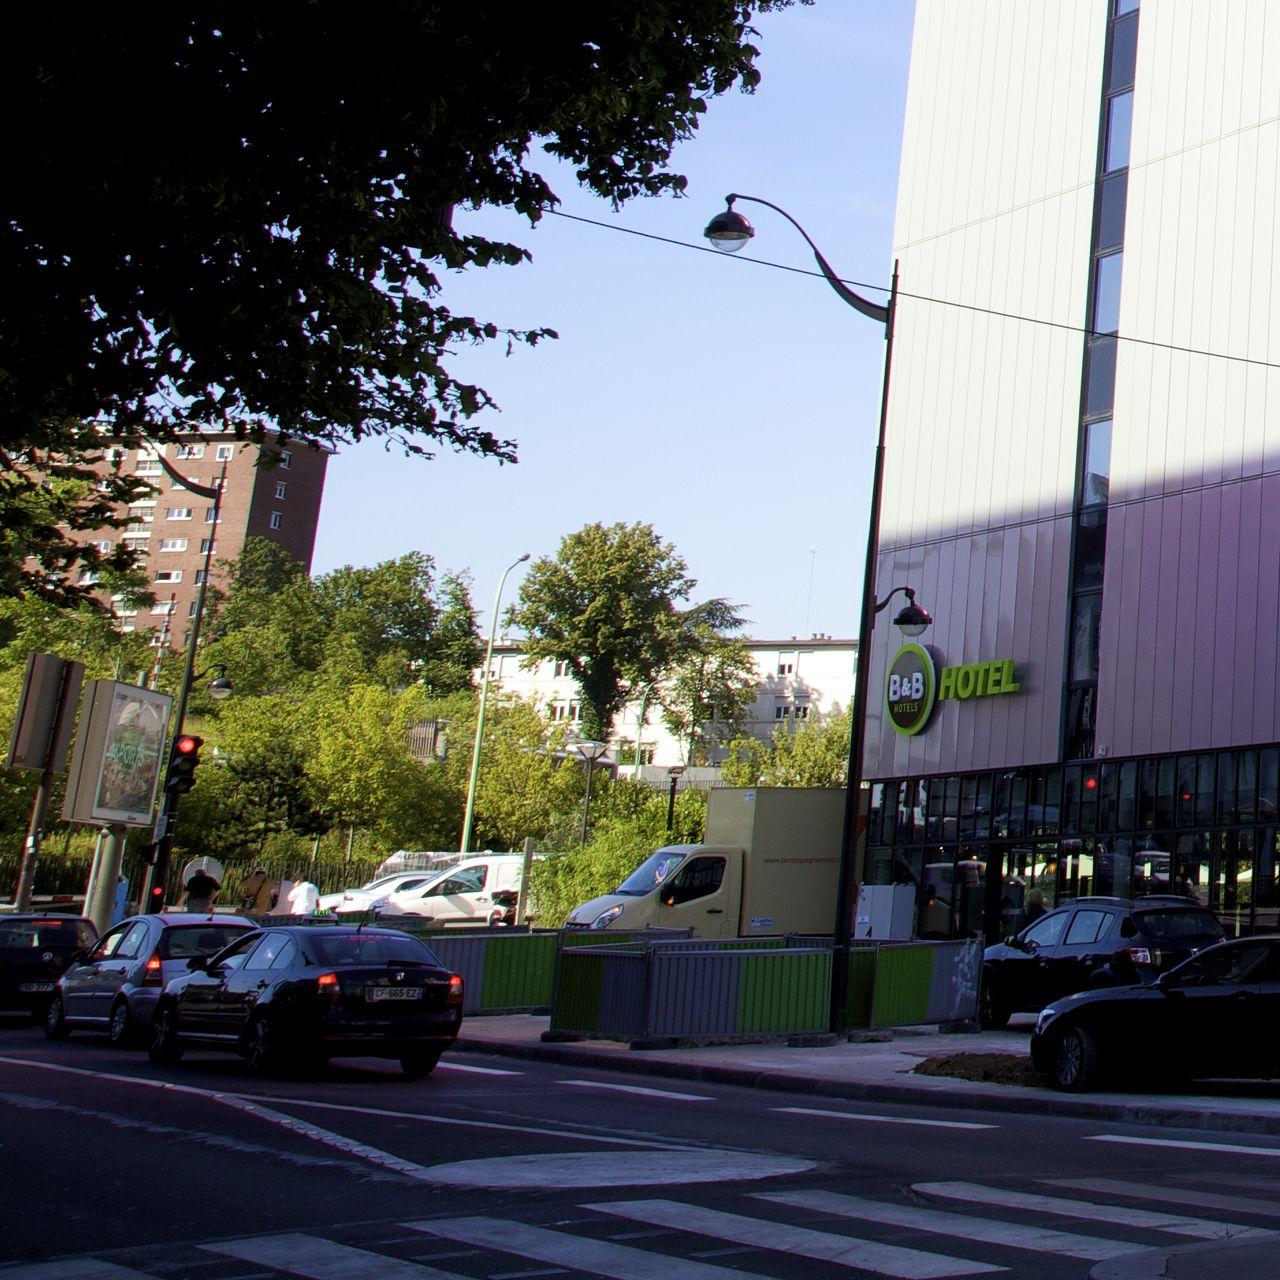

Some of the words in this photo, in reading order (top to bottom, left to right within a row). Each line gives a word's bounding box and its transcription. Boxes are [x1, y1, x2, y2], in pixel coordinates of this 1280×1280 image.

[888, 672, 924, 702] B&B
[938, 657, 1020, 701] HOTEL
[894, 702, 919, 713] HOTELS
